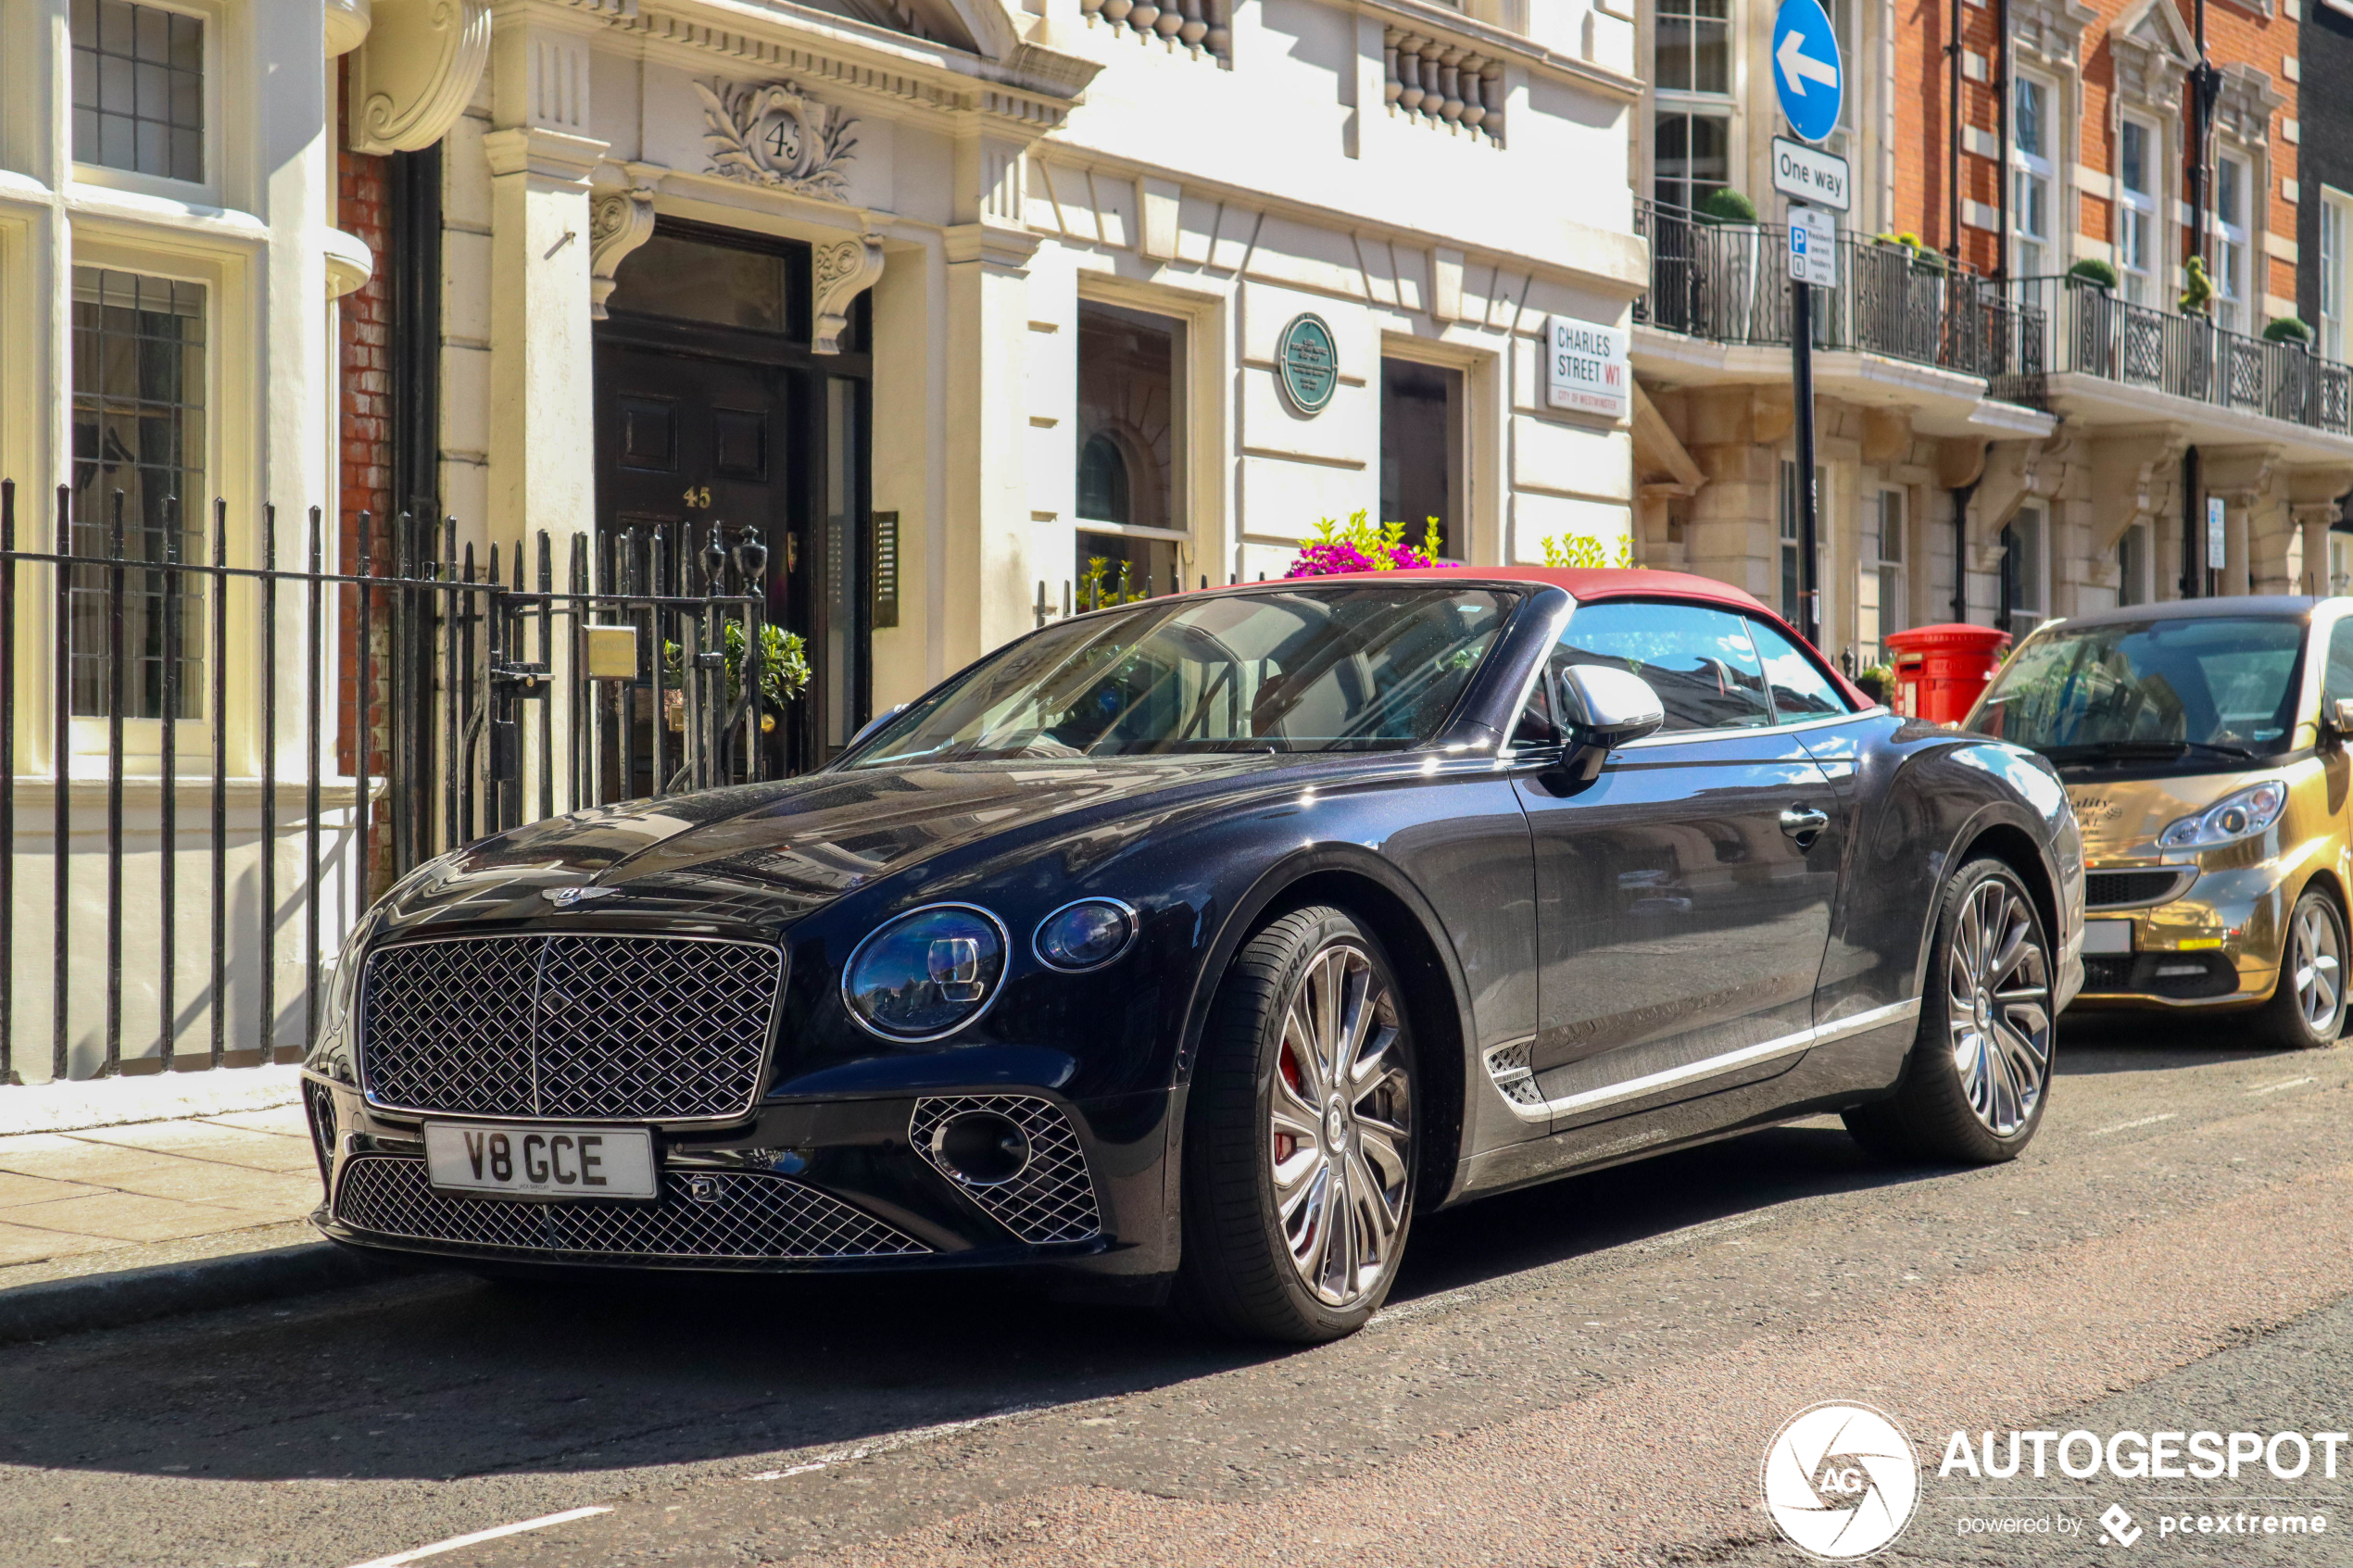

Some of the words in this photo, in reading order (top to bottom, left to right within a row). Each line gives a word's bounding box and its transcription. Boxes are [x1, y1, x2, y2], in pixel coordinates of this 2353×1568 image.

[765, 119, 800, 160] 45
[1780, 152, 1810, 184] One
[1814, 169, 1843, 198] way
[1793, 228, 1806, 251] P
[1807, 229, 1833, 244] Resident
[1811, 245, 1831, 257] permit
[1810, 257, 1831, 270] holders
[1815, 272, 1827, 282] only
[1557, 326, 1611, 358] CHARLES
[1558, 354, 1601, 383] STREET
[1604, 362, 1620, 387] W1
[1558, 389, 1570, 401] CITY
[1572, 392, 1579, 403] OF
[1579, 394, 1617, 410] WESTMINSTER
[683, 485, 711, 509] 45
[1275, 941, 1308, 1017] ZERO
[463, 1131, 513, 1183] V8
[523, 1134, 607, 1186] GCE
